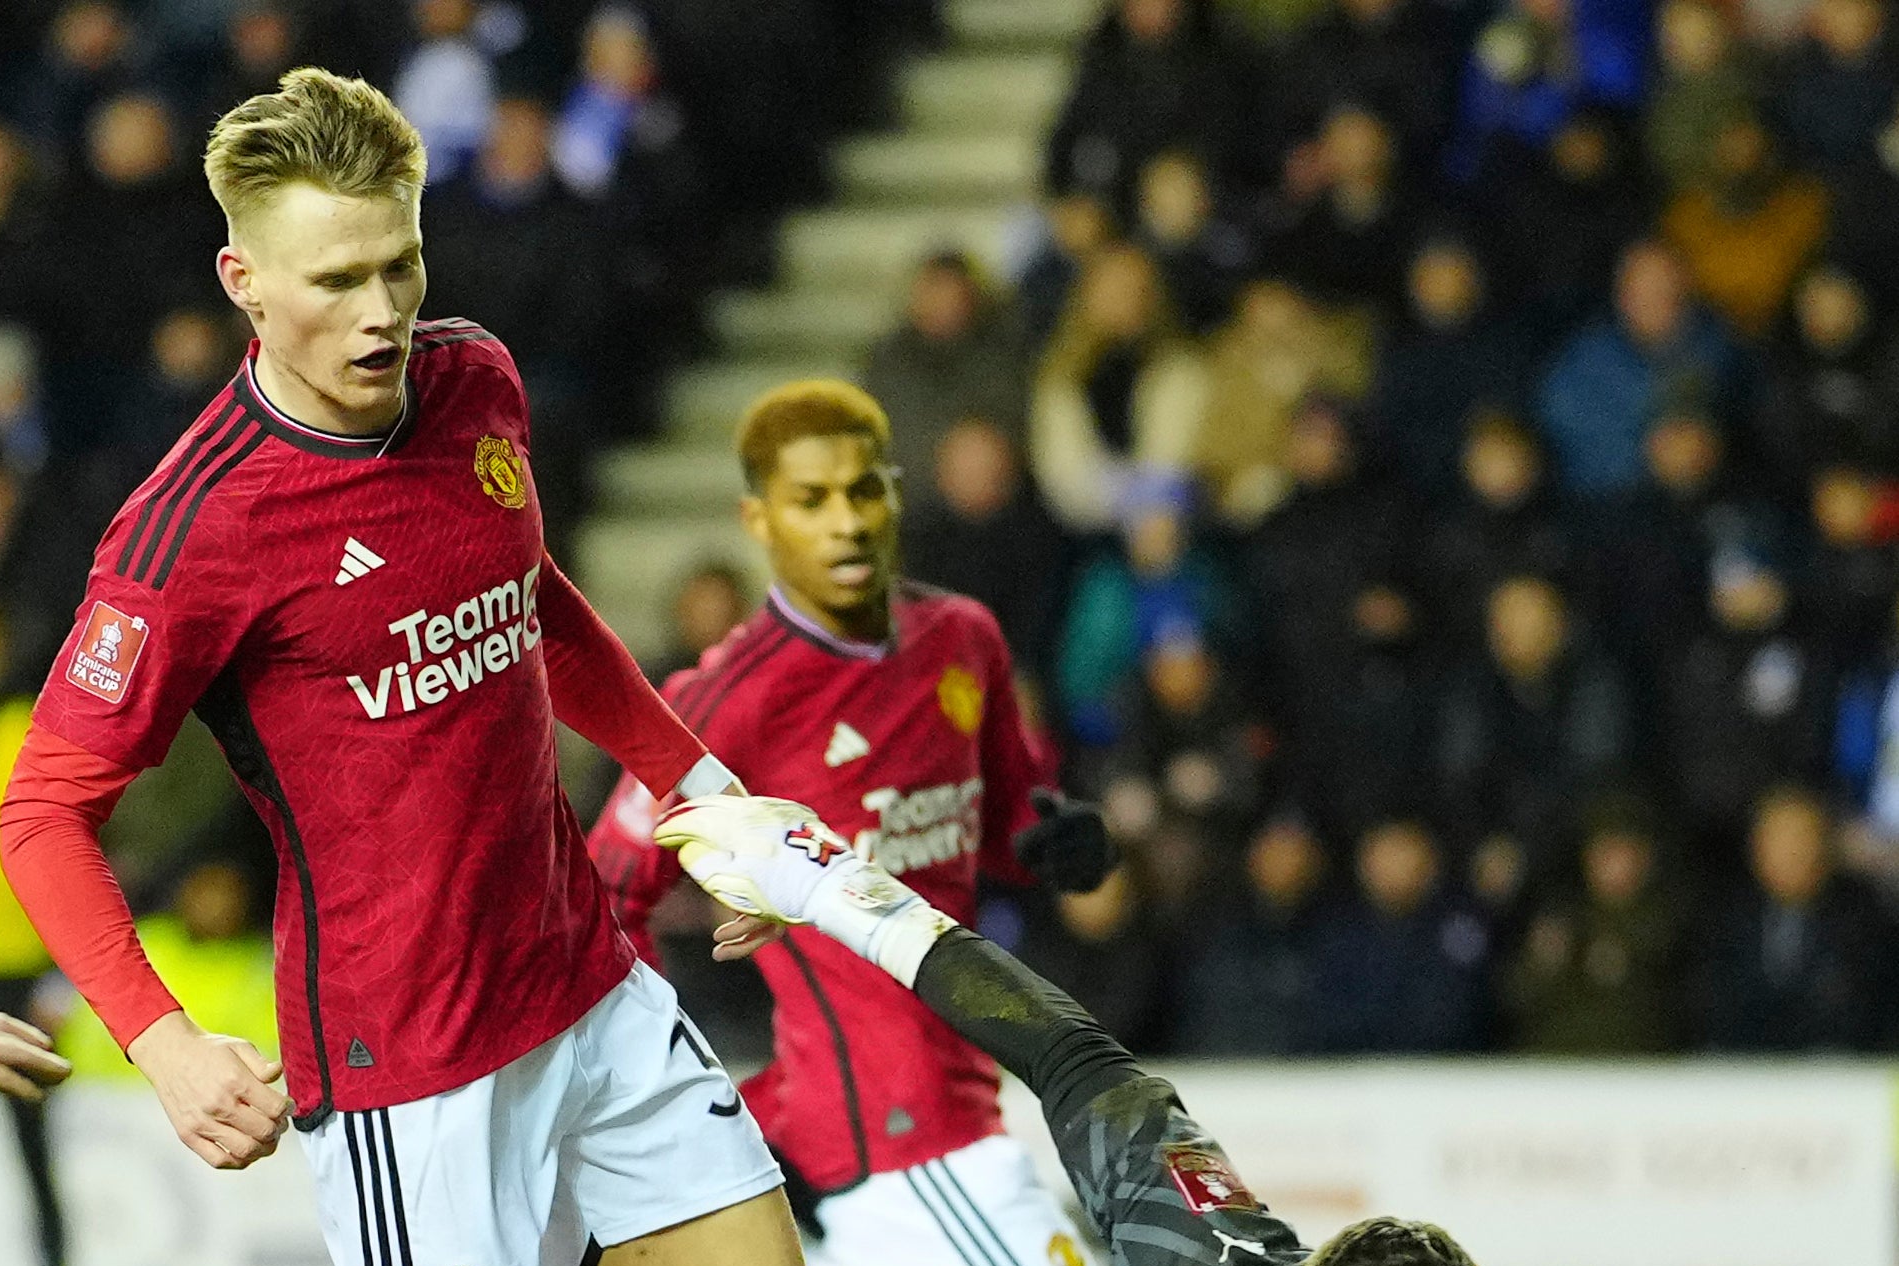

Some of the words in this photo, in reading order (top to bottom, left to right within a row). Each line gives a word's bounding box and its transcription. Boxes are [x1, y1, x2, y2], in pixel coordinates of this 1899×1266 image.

[388, 578, 520, 665] Team
[72, 662, 87, 681] FA
[88, 672, 120, 692] CUP
[76, 651, 121, 682] Emirates
[346, 620, 524, 720] Viewer
